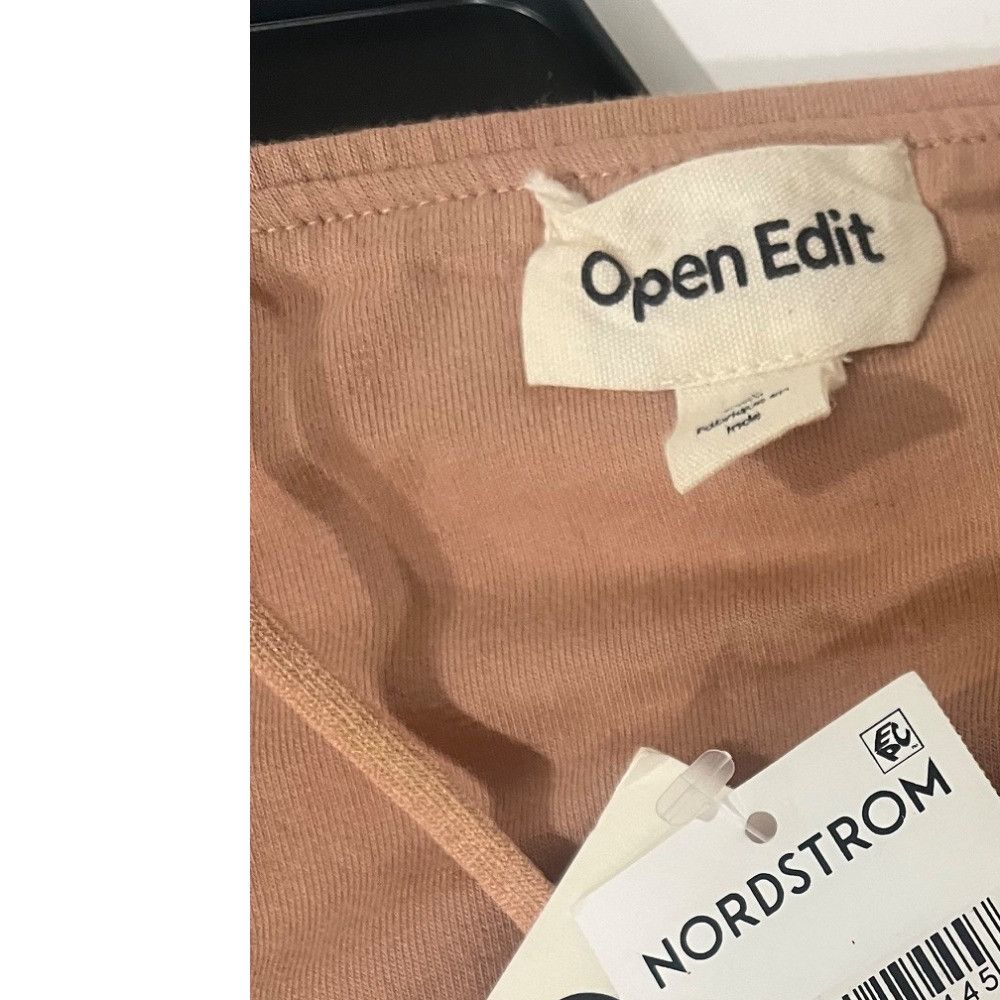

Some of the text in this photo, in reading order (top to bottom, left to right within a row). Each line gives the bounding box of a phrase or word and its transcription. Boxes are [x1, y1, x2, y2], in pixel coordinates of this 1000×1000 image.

[581, 209, 885, 323] Open Edit
[642, 758, 952, 989] NORDSTROM
